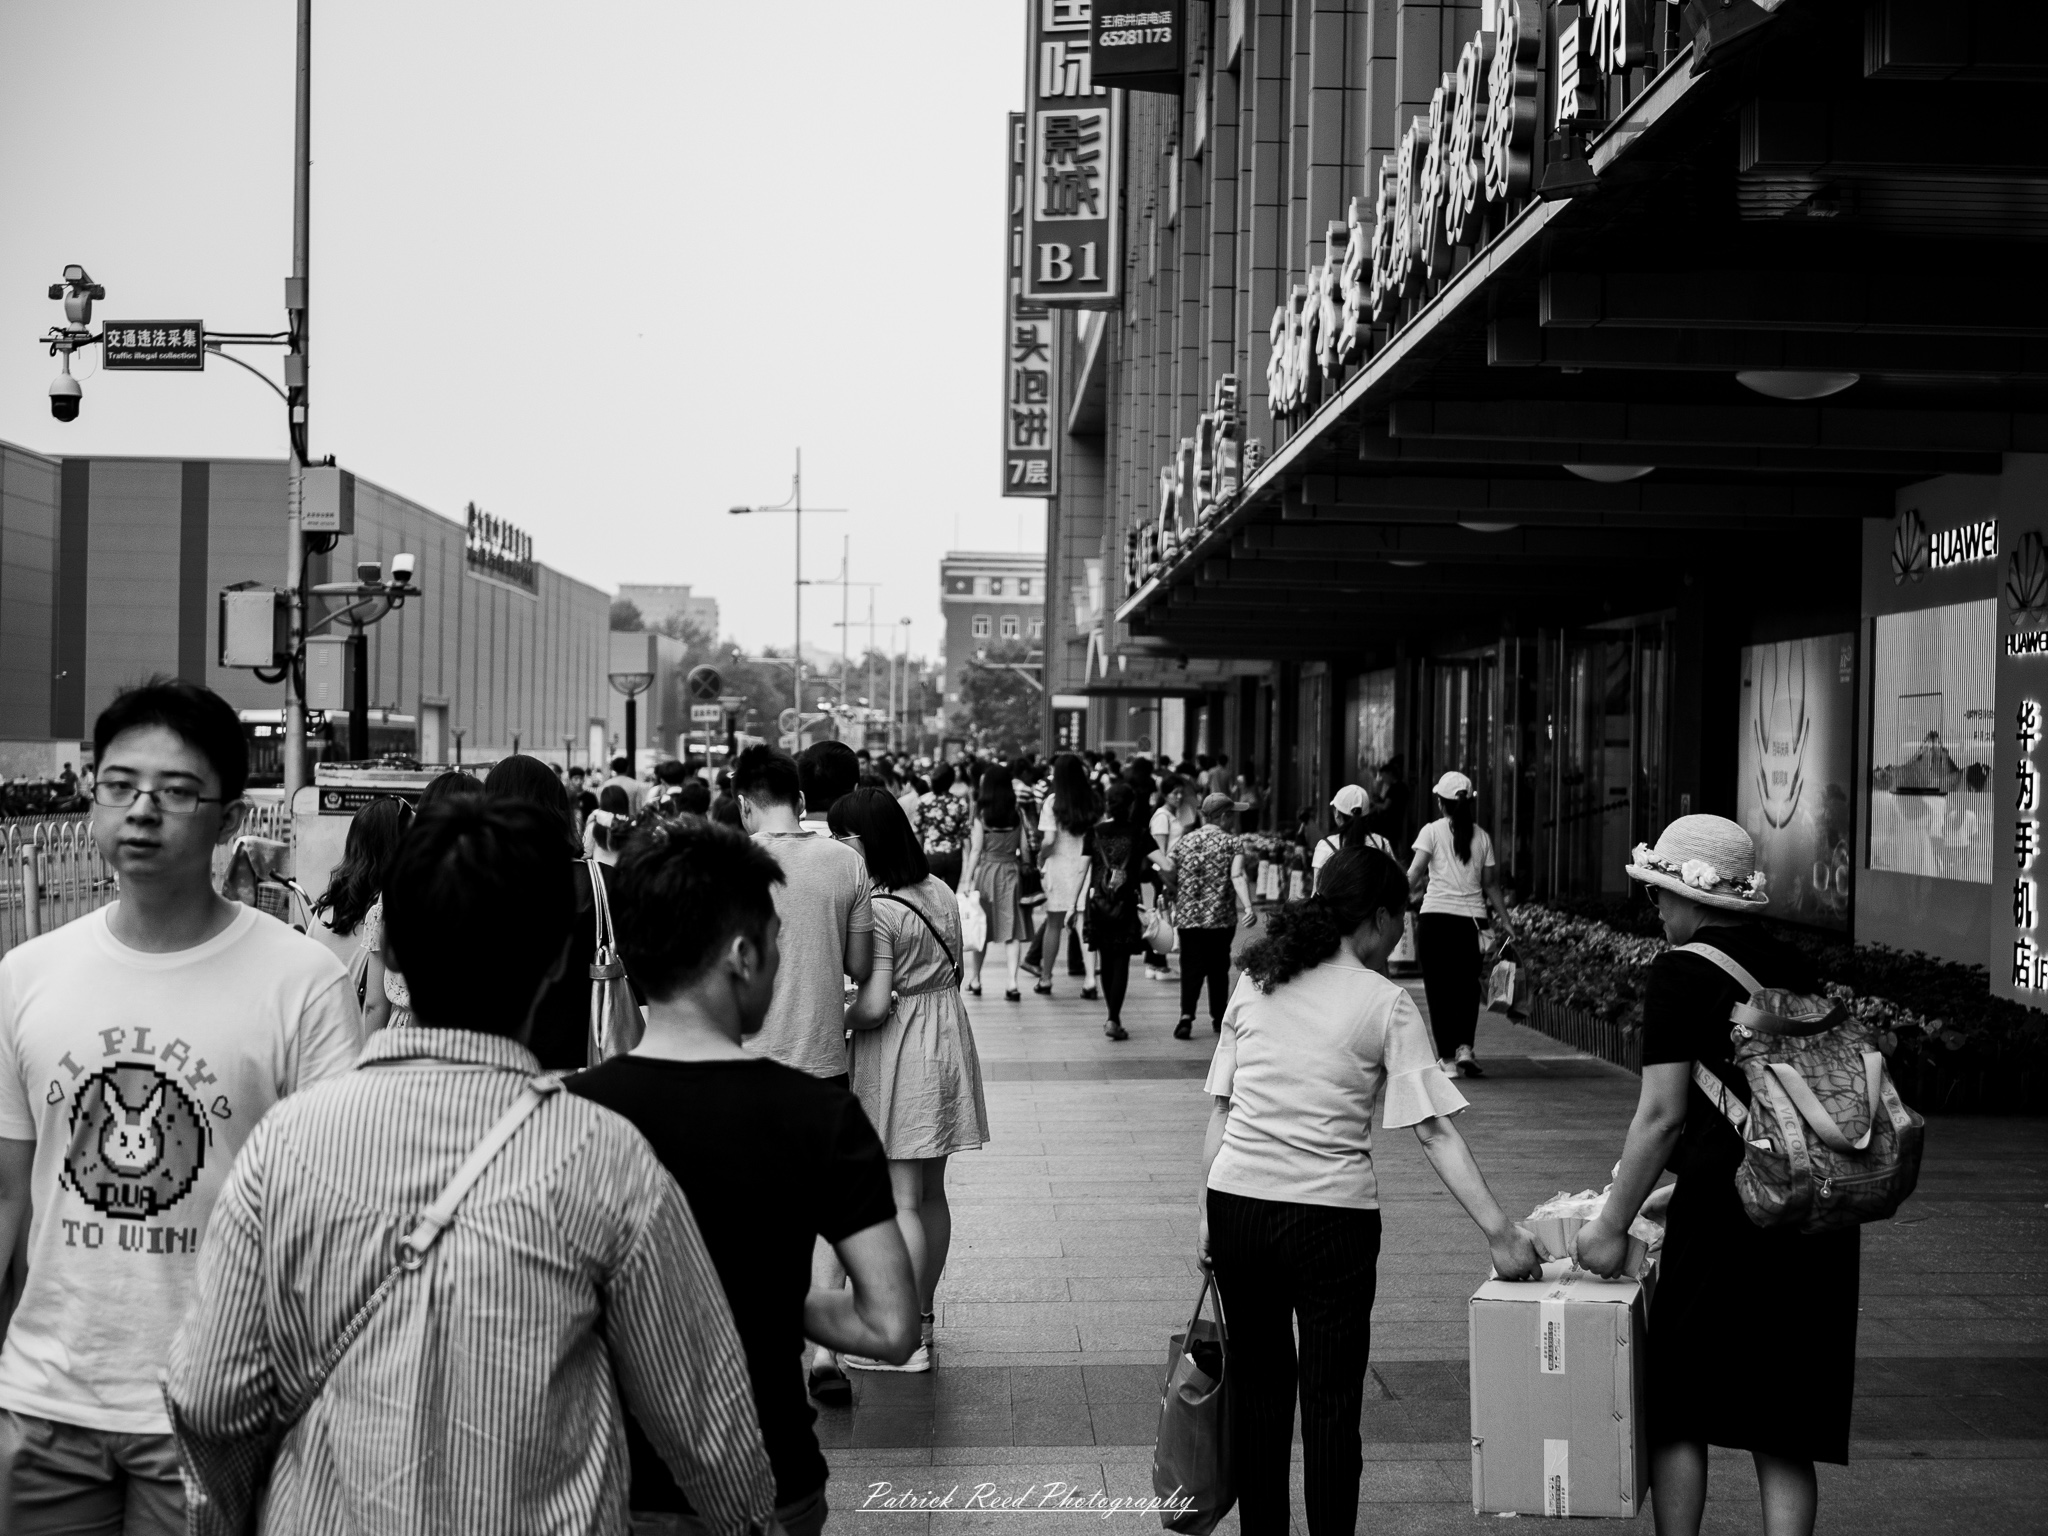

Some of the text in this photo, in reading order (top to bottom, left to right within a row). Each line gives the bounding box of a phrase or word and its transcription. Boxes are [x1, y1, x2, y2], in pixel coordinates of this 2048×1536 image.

[1100, 11, 1173, 28] 王府井店电话
[1099, 27, 1173, 47] 65281173
[1036, 241, 1102, 282] B1
[107, 328, 197, 348] 交通违法采集
[107, 351, 198, 361] Traffic illegal collection
[1008, 458, 1049, 485] 7层
[1928, 519, 1999, 568] HUAWEI
[2012, 700, 2036, 988] 华为手机店
[58, 1026, 218, 1091] I PLAY
[62, 1219, 197, 1254] TO WIN!
